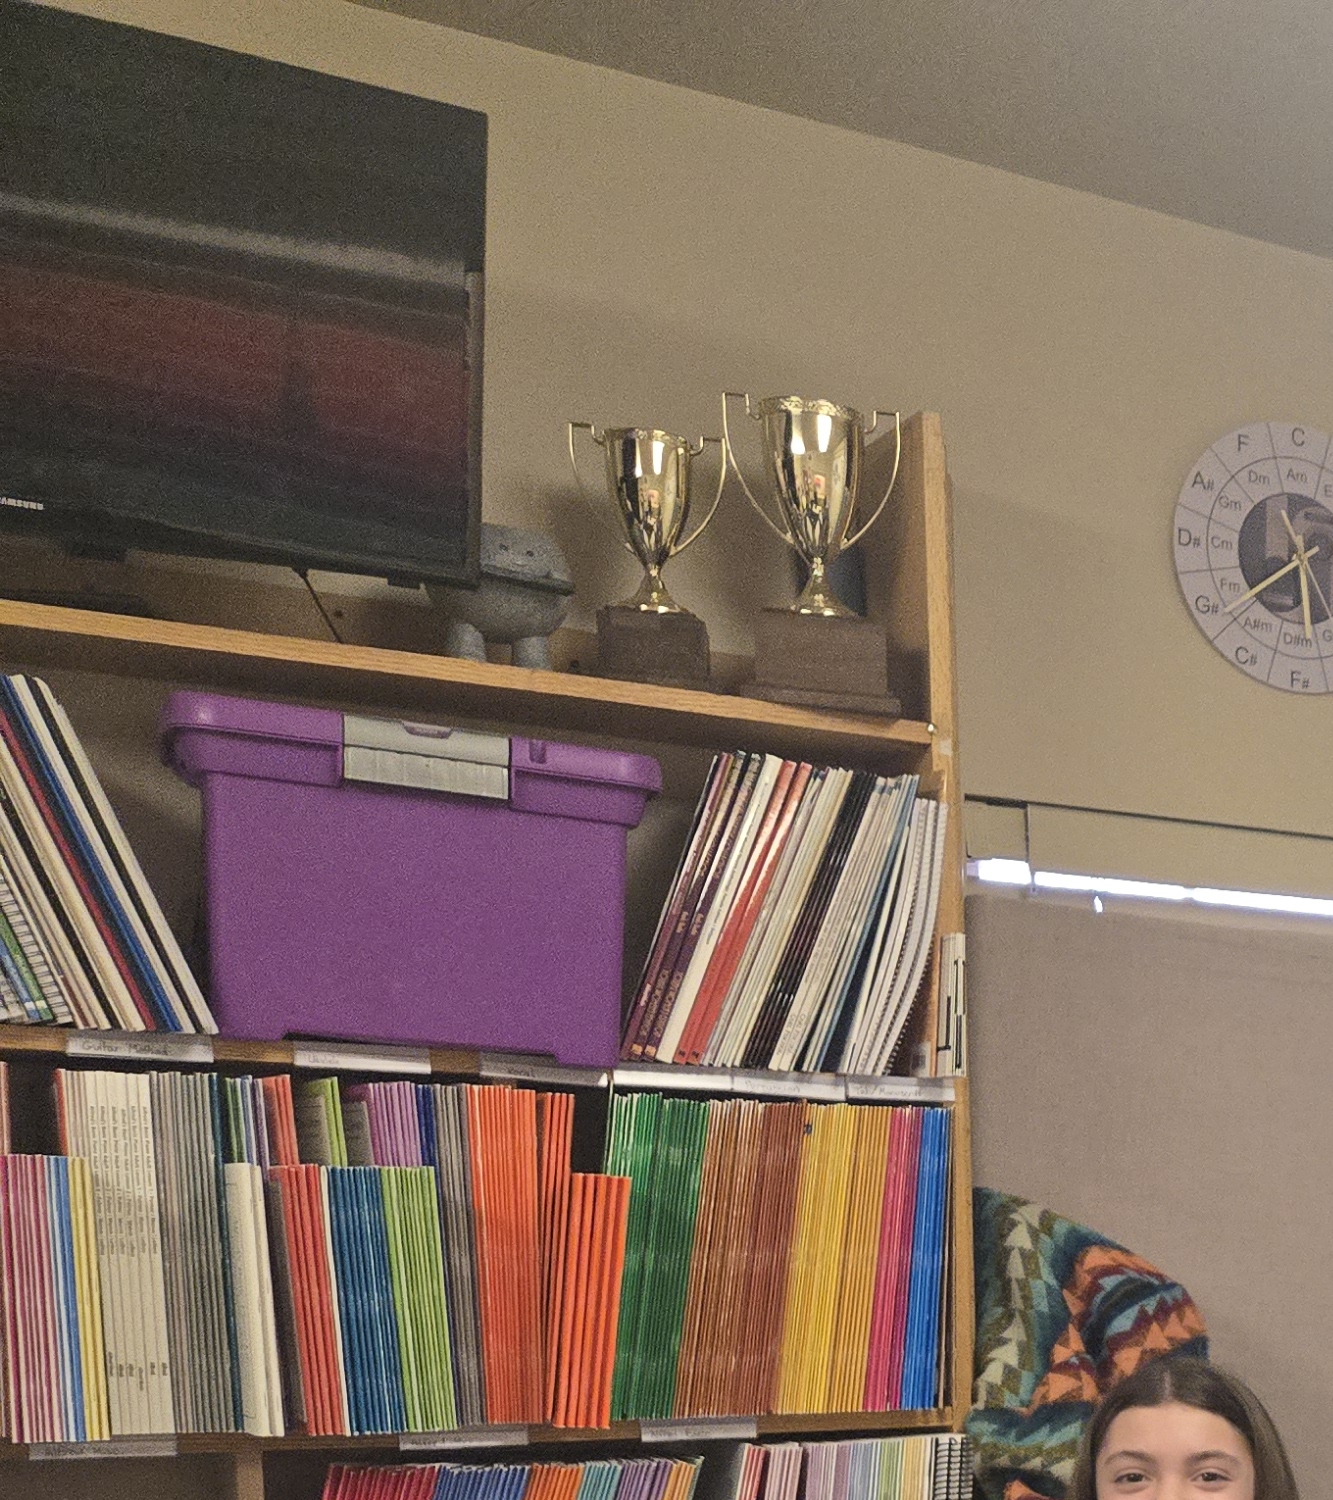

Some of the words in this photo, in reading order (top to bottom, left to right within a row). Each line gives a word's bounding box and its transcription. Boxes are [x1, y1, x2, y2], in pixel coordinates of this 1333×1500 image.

[1238, 434, 1248, 451] F
[1291, 428, 1305, 447] C
[1192, 472, 1214, 490] A#
[1249, 470, 1270, 484] Dm
[1286, 469, 1307, 483] Am
[0, 496, 44, 511] AMSUNG
[1219, 496, 1242, 511] Gm
[1178, 528, 1200, 547] D#
[1212, 535, 1232, 548] Cm
[1220, 579, 1240, 592] Fm
[1195, 596, 1218, 614] G#
[1244, 617, 1272, 632] A#m
[1236, 646, 1257, 666] C#
[1290, 671, 1309, 688] F#
